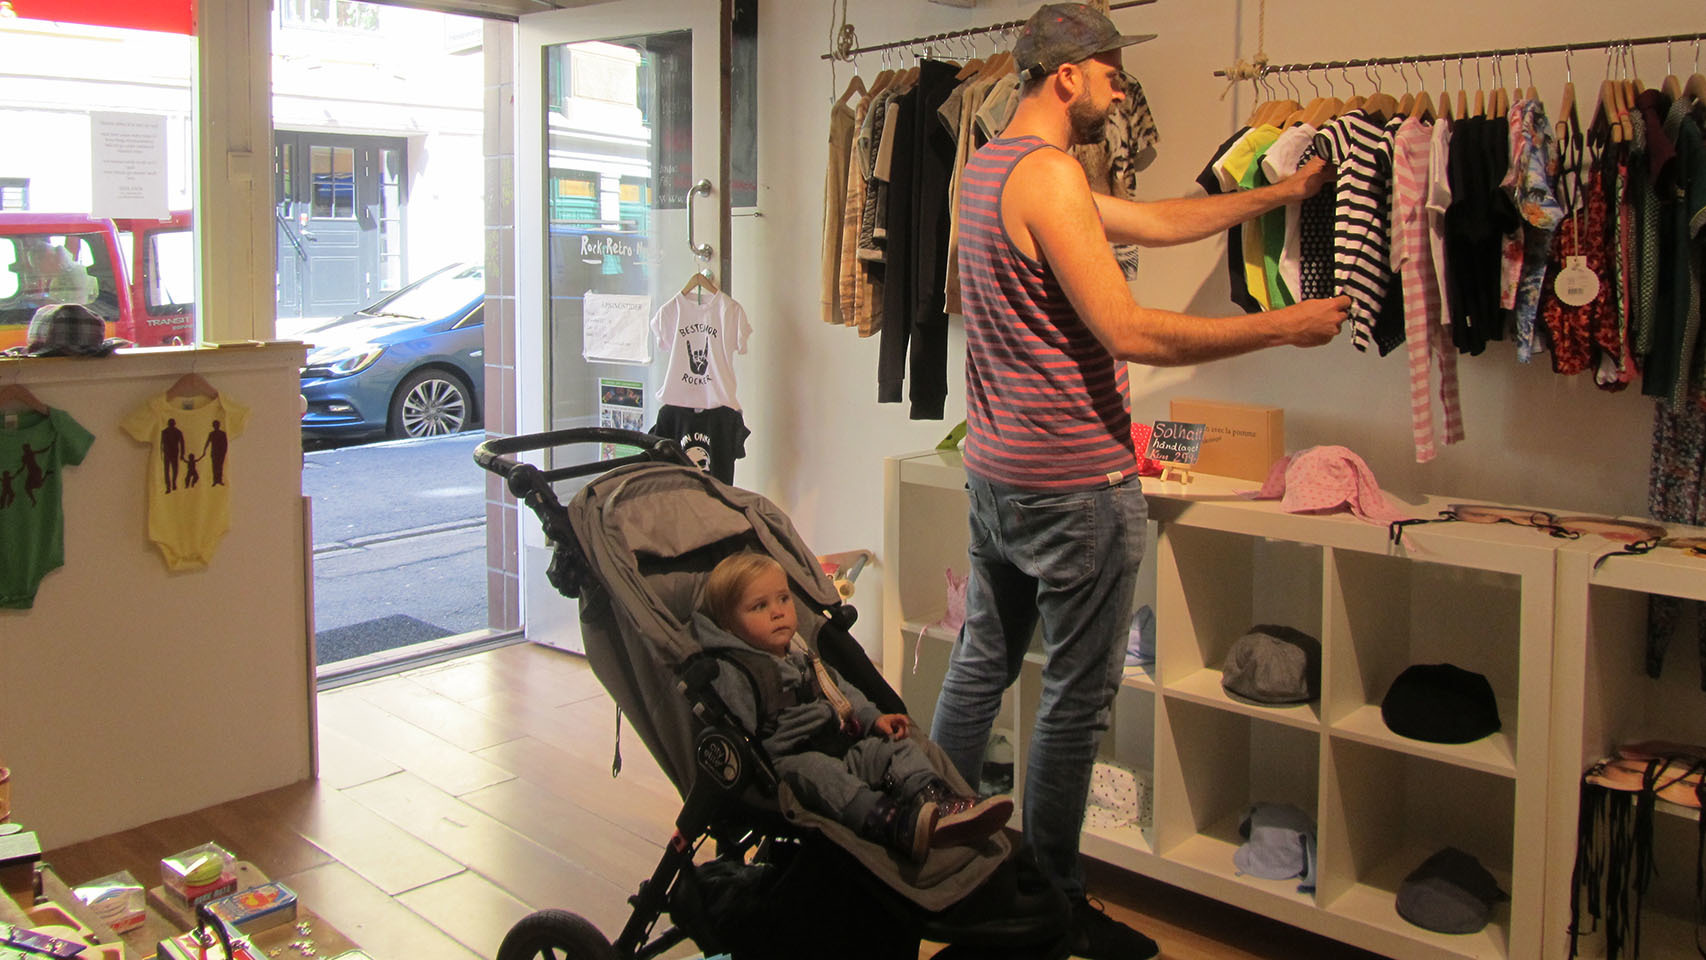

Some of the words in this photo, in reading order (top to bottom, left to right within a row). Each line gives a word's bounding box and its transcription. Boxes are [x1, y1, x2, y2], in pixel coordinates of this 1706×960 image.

[580, 235, 603, 256] Rock
[606, 237, 633, 257] Retro
[147, 316, 190, 327] TRANSIT
[679, 323, 718, 338] BESTEMOR
[681, 373, 713, 385] ROCKER
